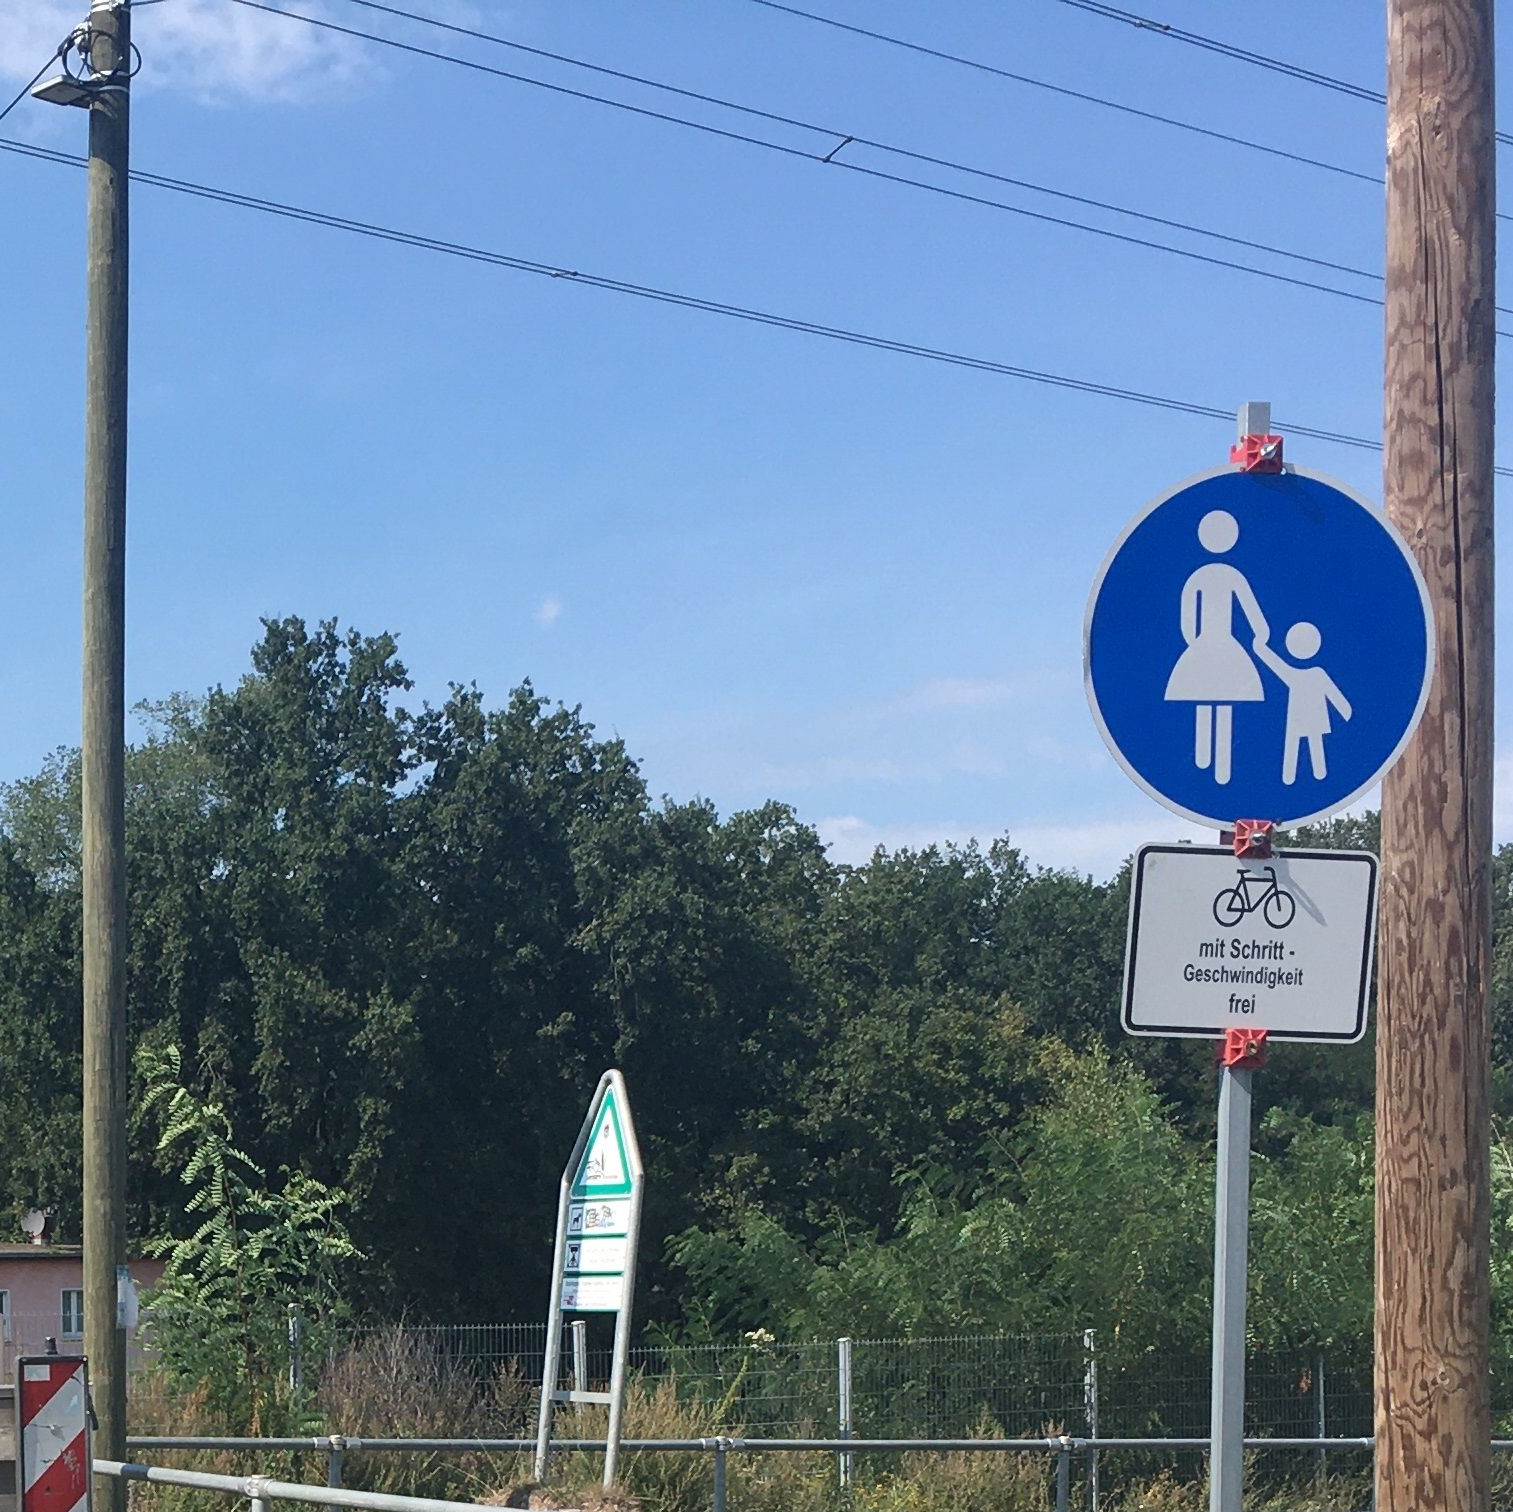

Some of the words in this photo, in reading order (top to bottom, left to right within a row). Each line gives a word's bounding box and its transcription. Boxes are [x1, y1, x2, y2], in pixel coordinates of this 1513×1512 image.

[1199, 937, 1225, 958] mit
[1230, 938, 1284, 960] Schritt
[1183, 963, 1304, 989] Geschwindigkeit
[1228, 993, 1256, 1014] frei
